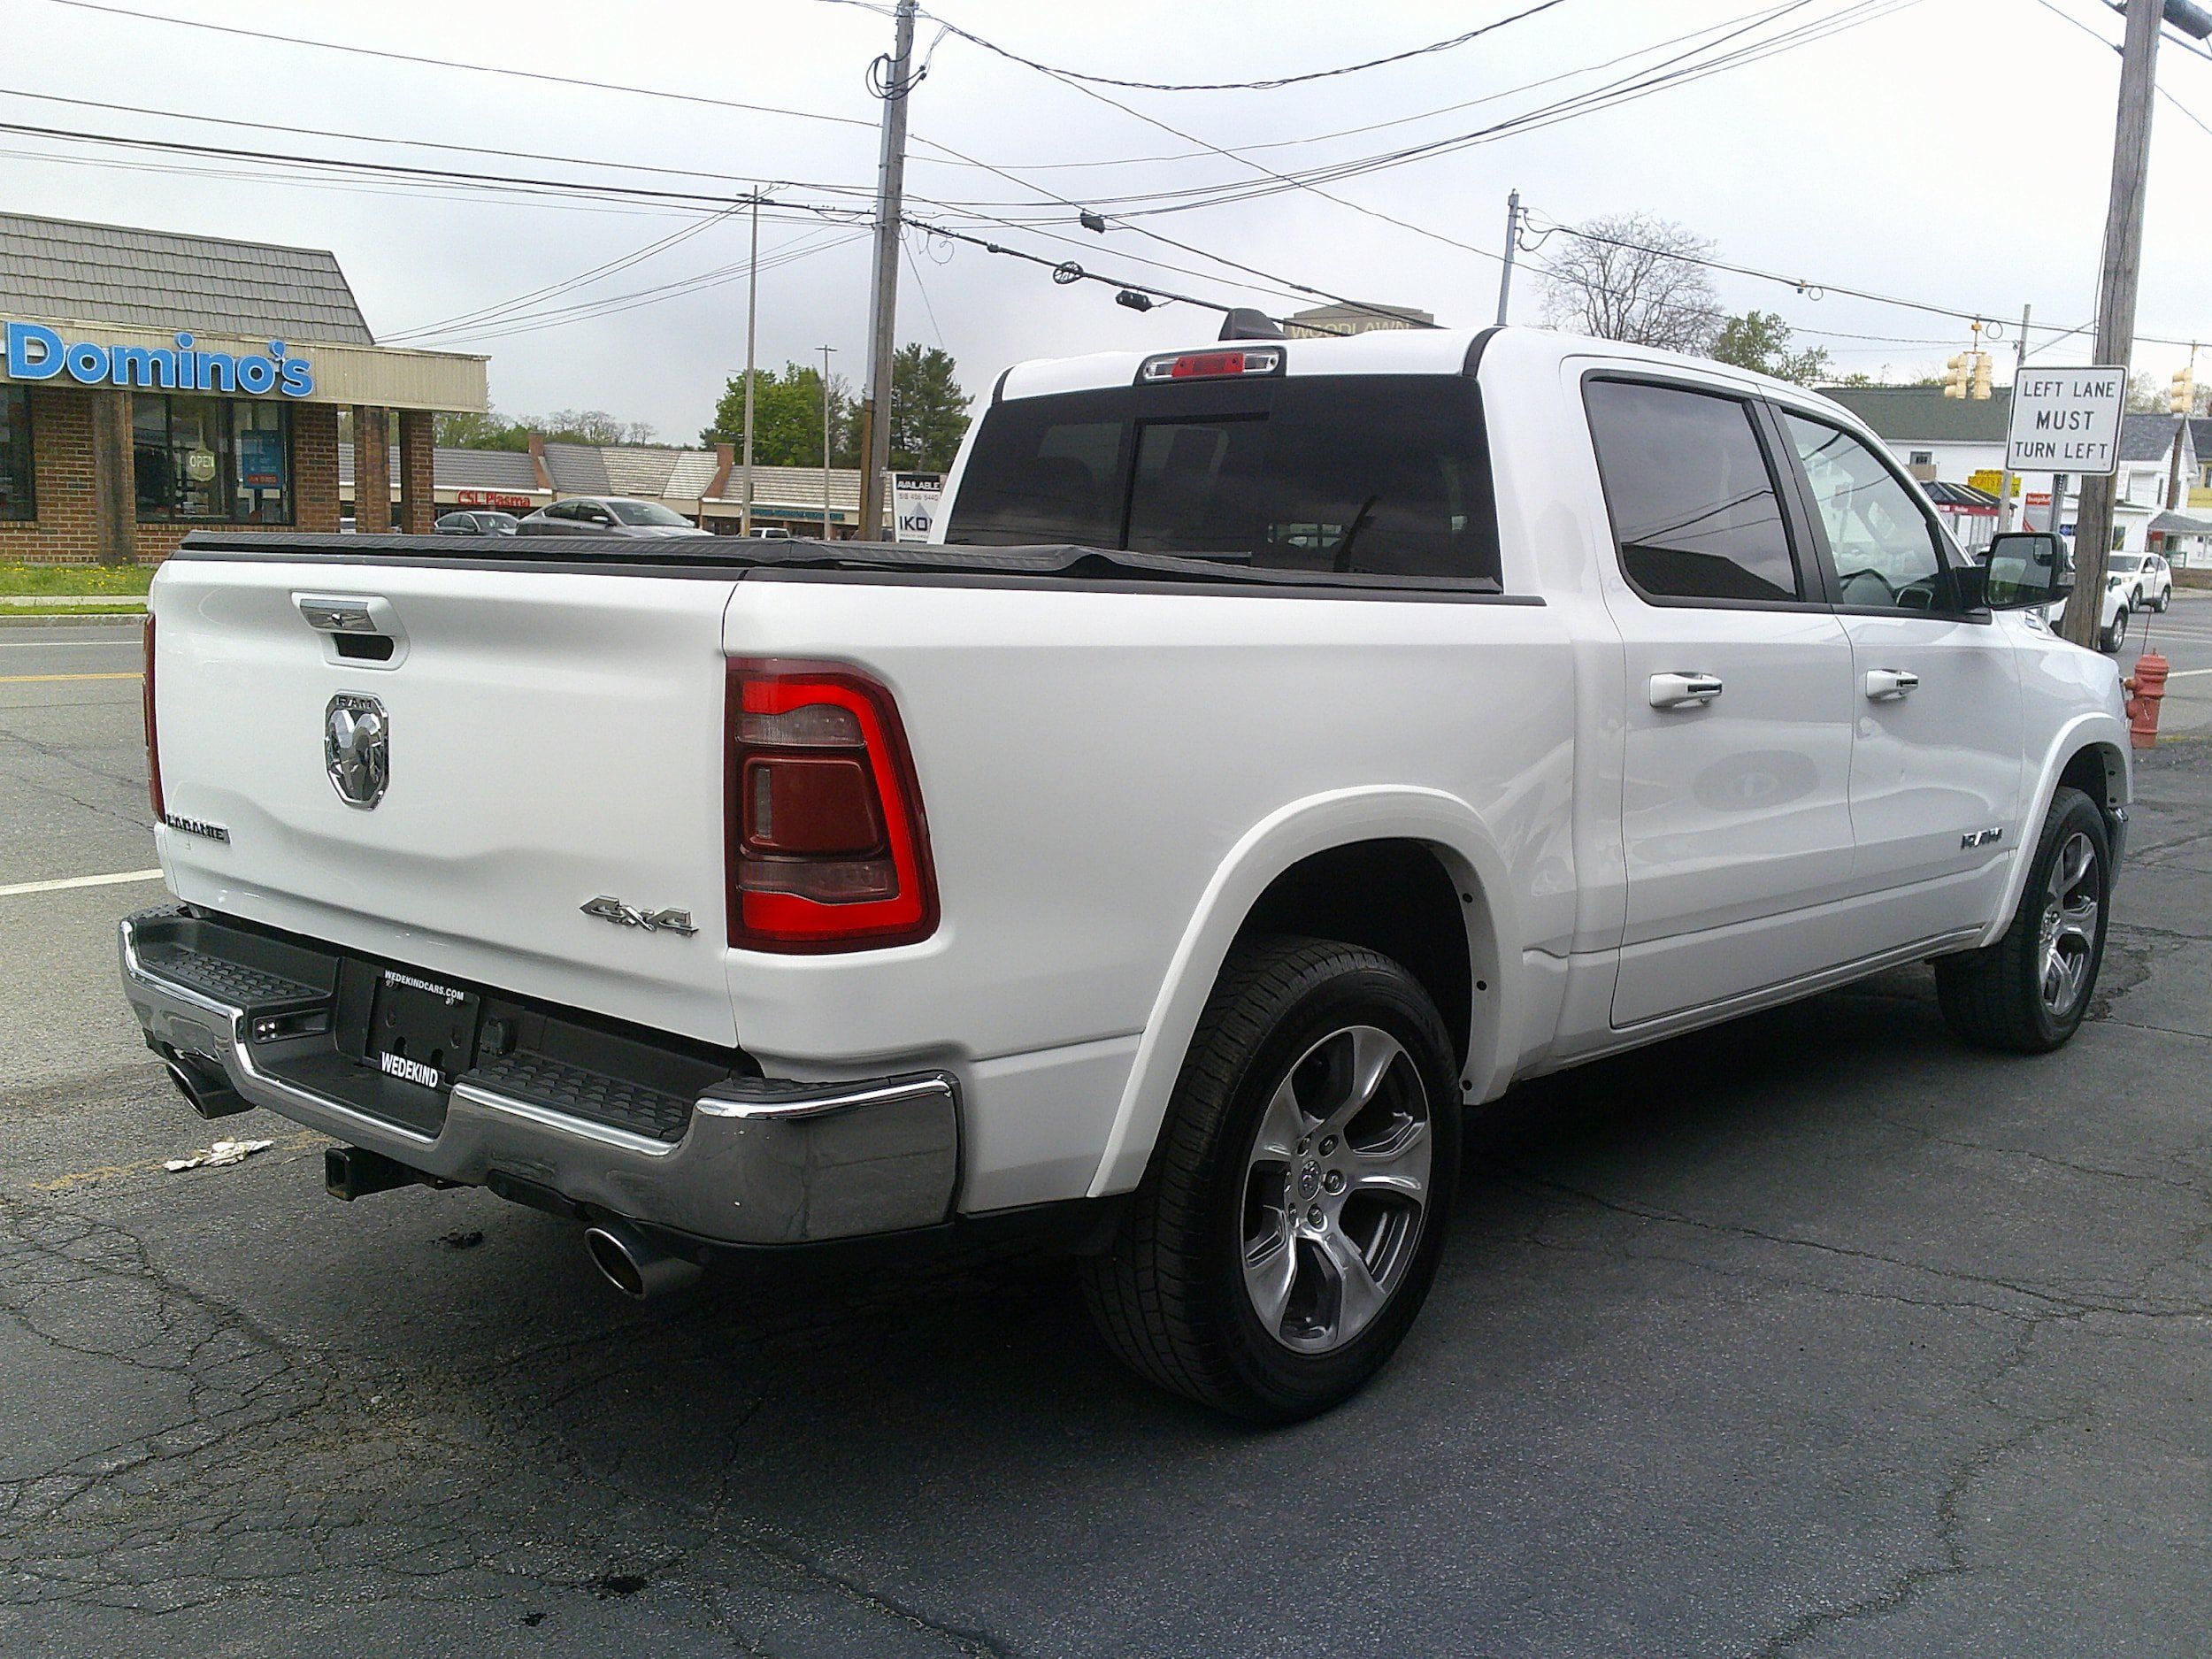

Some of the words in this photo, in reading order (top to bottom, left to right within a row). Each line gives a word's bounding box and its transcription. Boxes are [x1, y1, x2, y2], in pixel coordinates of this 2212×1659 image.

[6, 321, 314, 397] Domino's
[2024, 381, 2063, 396] LEFT
[2073, 381, 2116, 397] LANE
[2036, 411, 2094, 430] MUST
[2016, 442, 2055, 457] TURN
[2064, 442, 2108, 458] LEFT
[189, 455, 215, 468] OPEN
[897, 480, 940, 490] AVAILABLE
[457, 490, 482, 506] CSL
[485, 492, 531, 508] Plasma
[336, 696, 372, 710] RAM
[1961, 826, 2002, 850] RAM
[384, 970, 465, 1001] WEDEKINDCARS.COM
[380, 1051, 439, 1088] WEDEKIND
